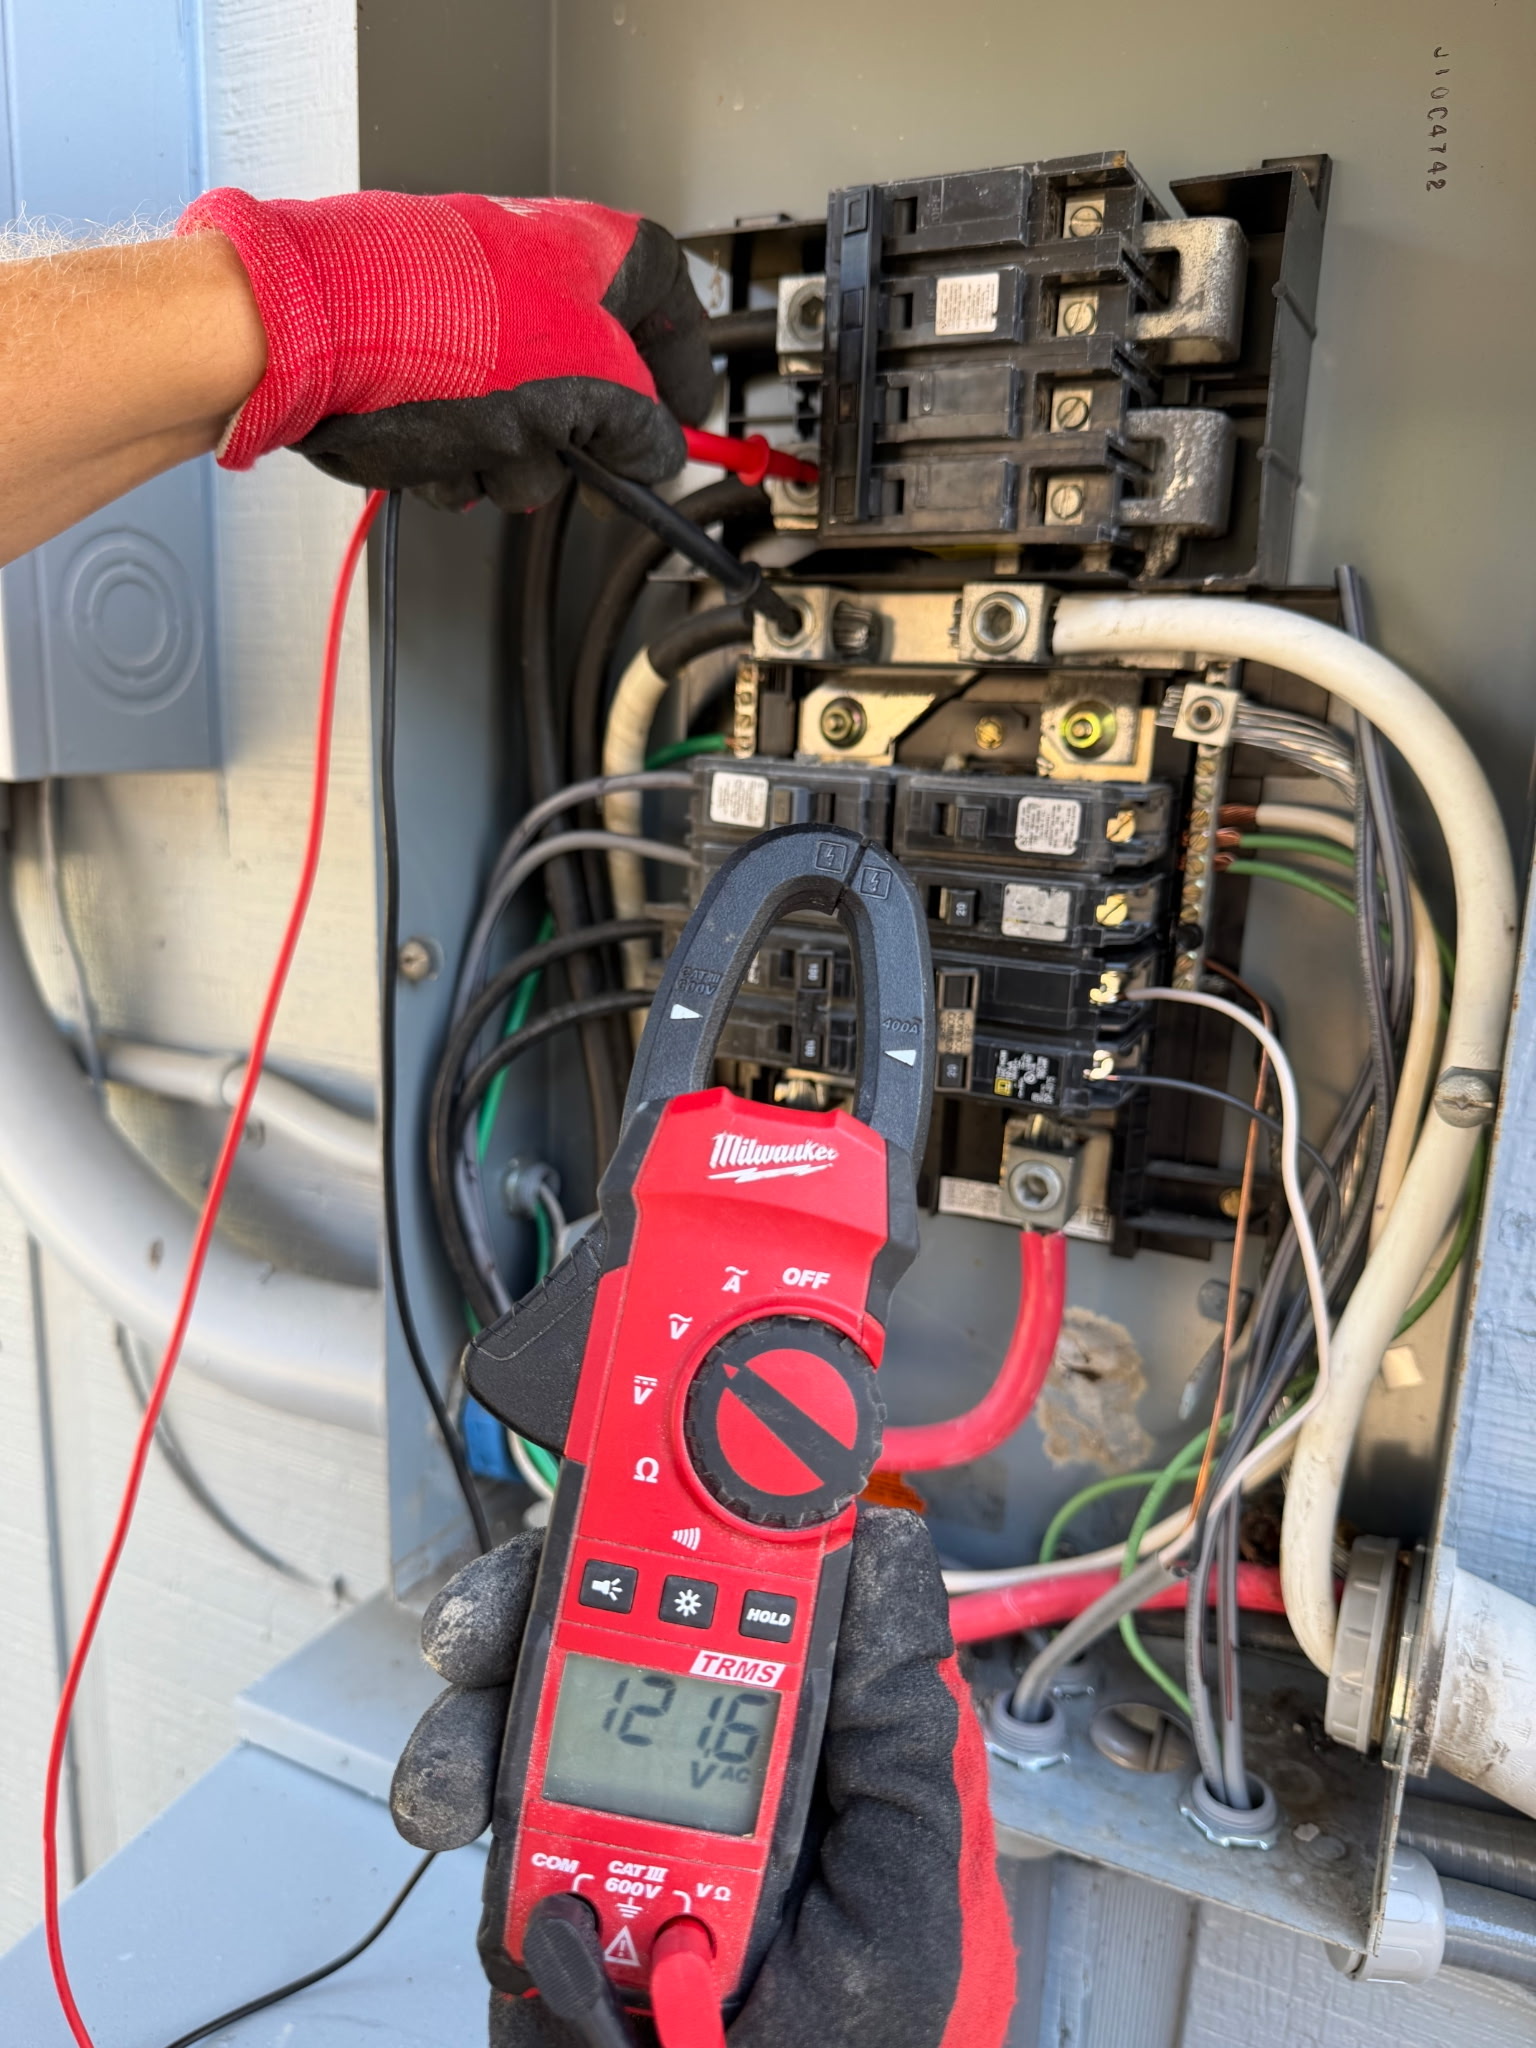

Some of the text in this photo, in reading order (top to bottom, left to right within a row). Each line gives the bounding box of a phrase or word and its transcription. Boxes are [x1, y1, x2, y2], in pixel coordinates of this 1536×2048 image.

[709, 1131, 839, 1169] Milwaukee
[781, 1267, 831, 1290] OFF
[746, 1608, 791, 1627] HOLD
[700, 1653, 777, 1684] TRMS
[531, 1852, 580, 1874] COM
[608, 1860, 647, 1879] CAT
[604, 1877, 662, 1899] 600V
